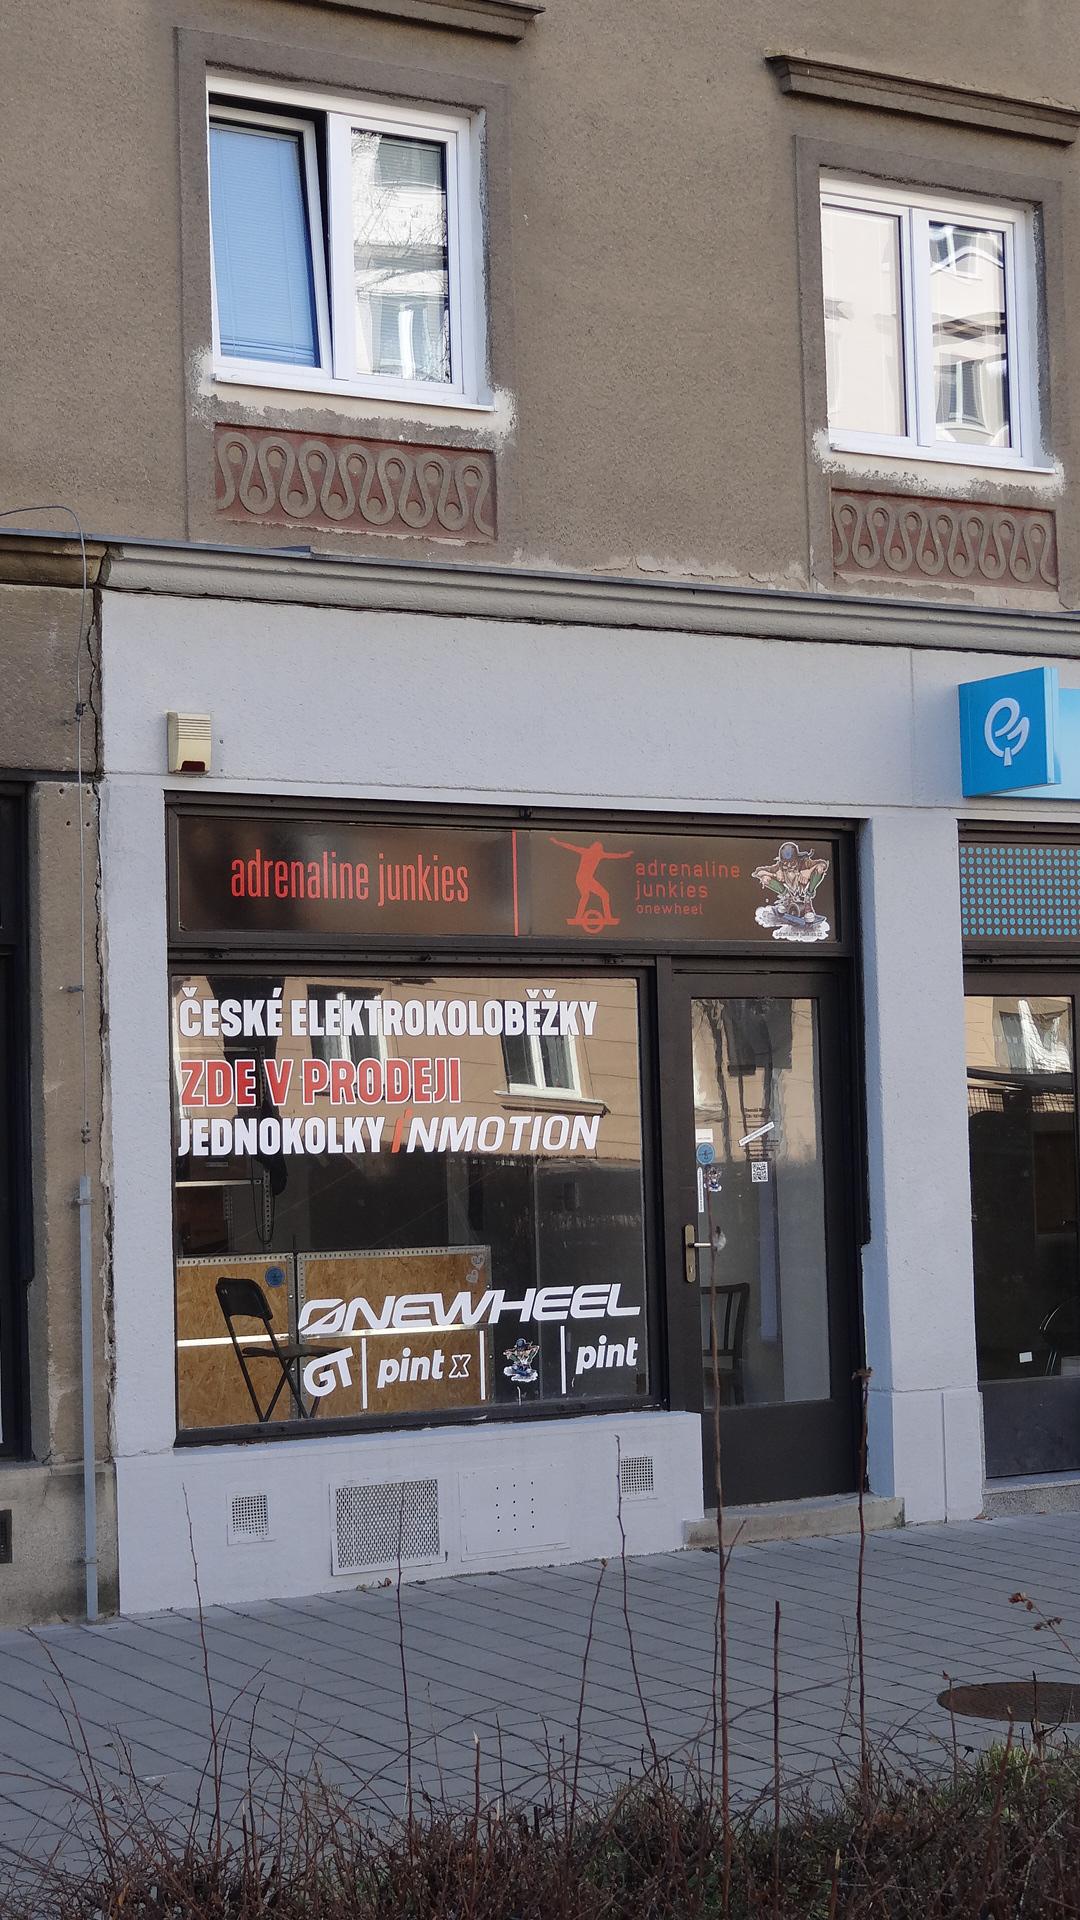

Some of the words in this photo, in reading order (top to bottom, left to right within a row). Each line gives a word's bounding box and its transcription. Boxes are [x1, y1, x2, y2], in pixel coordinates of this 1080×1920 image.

[231, 848, 369, 900] adrenaline
[377, 852, 469, 907] junkies
[635, 859, 741, 878] adrenaline
[635, 880, 709, 900] junkies
[636, 903, 704, 915] onewheel
[179, 987, 283, 1037] ČESKÉ
[291, 988, 598, 1037] ELEKTROKOLOBĚŽKY
[180, 1058, 257, 1107] ZDE
[263, 1058, 294, 1106] V
[303, 1057, 462, 1106] PRODEJI
[178, 1116, 386, 1156] JEDNOKOLKY
[303, 1347, 354, 1397] GT
[376, 1347, 445, 1389] pint
[575, 1334, 639, 1375] pint
